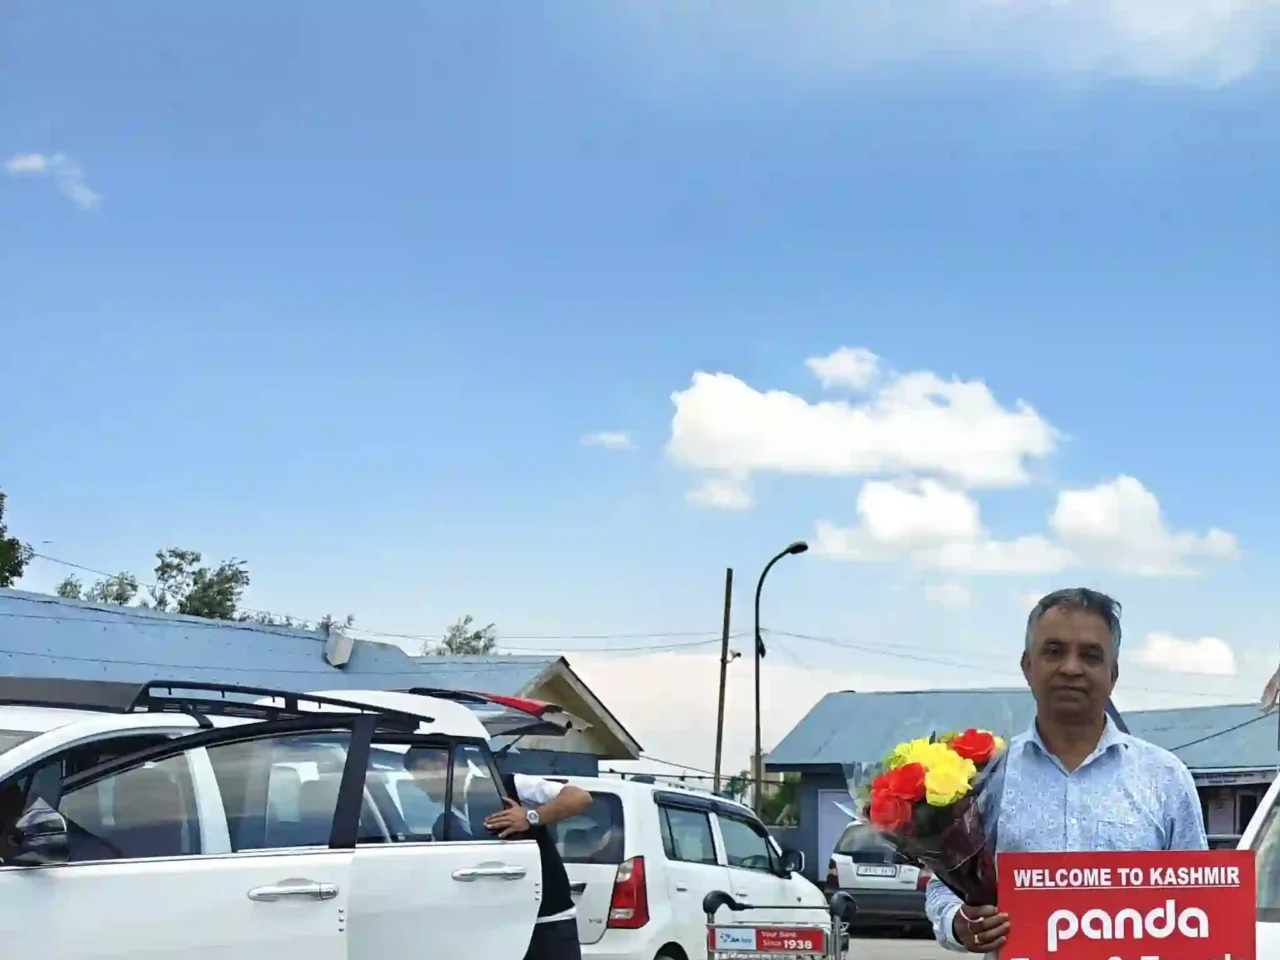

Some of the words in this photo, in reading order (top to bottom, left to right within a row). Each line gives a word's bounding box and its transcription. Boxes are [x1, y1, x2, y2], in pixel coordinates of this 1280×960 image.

[1013, 868, 1112, 888] WELCOME
[1117, 868, 1144, 886] TO
[1149, 866, 1240, 886] KASHMIR
[1047, 898, 1209, 952] panda
[783, 939, 813, 950] 1938
